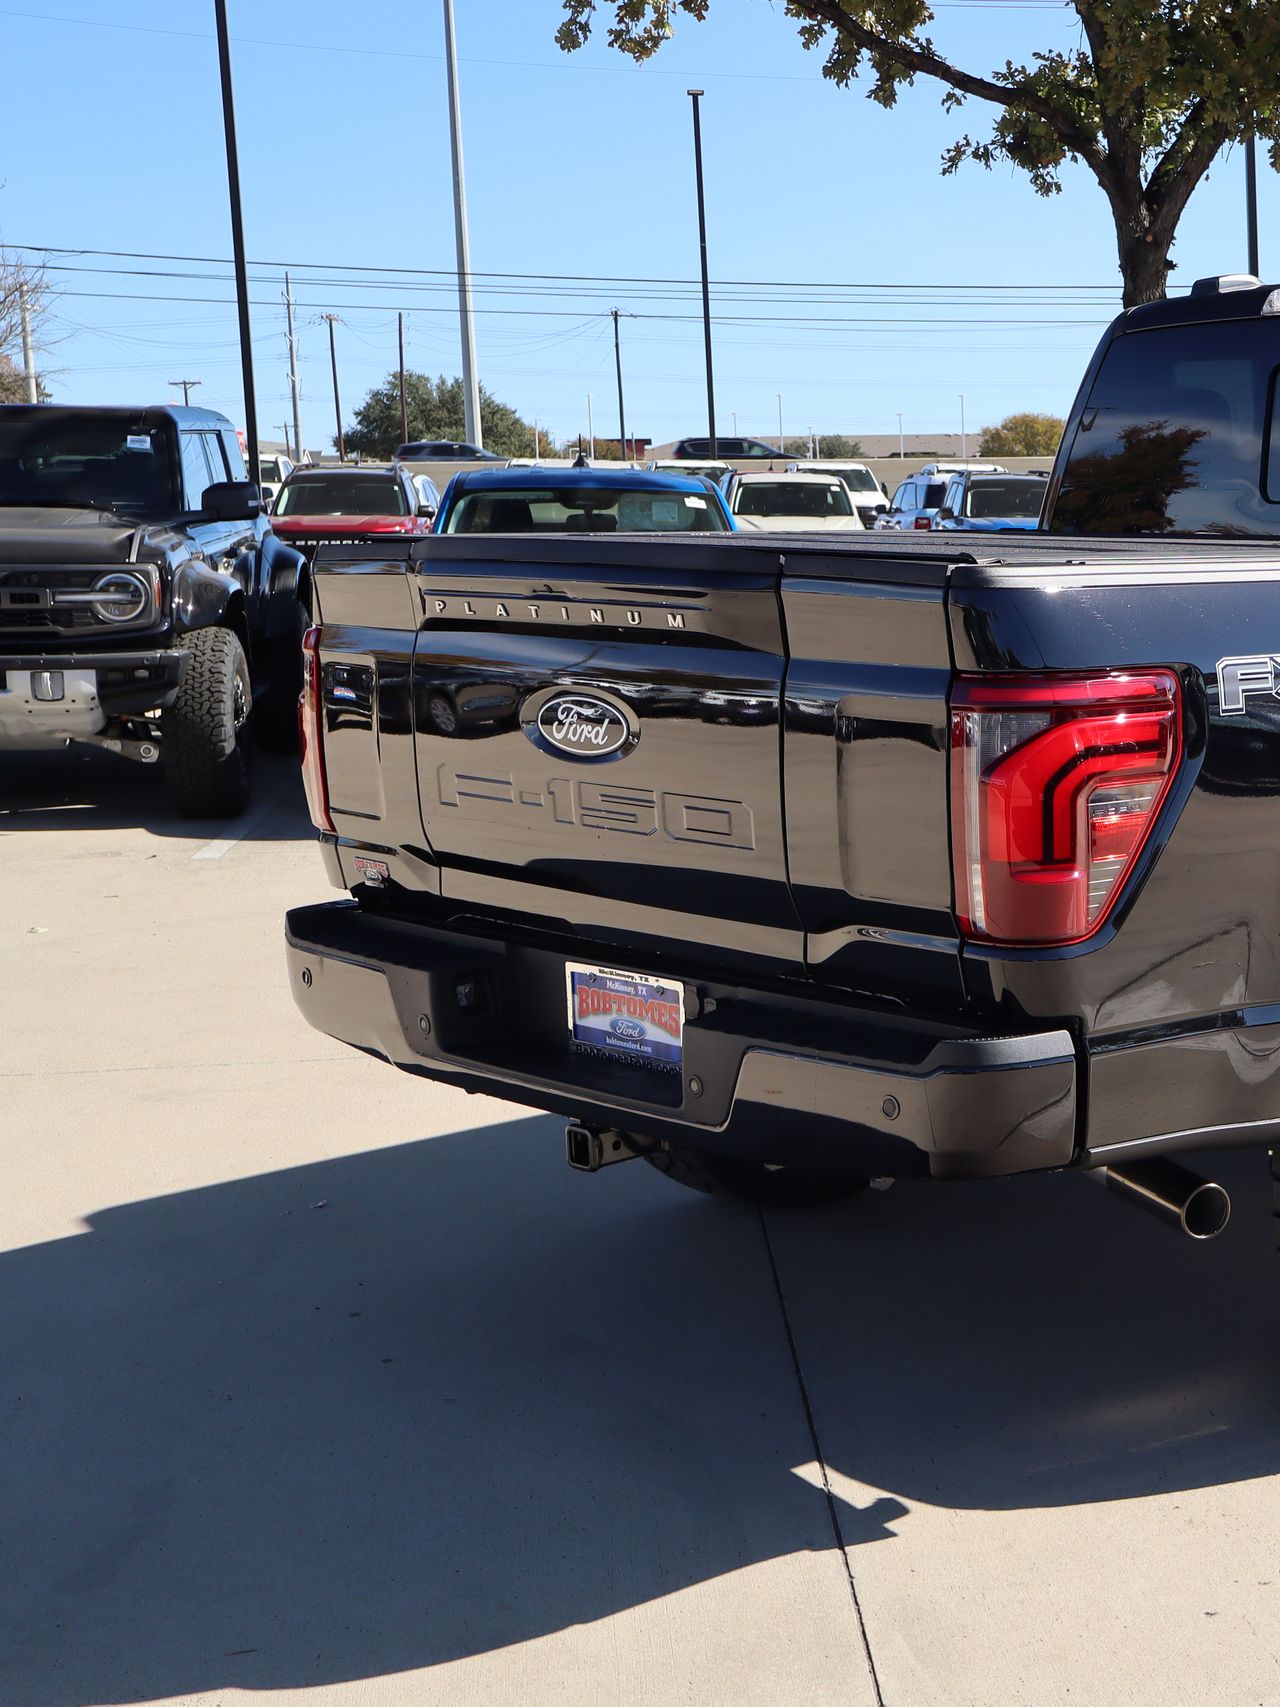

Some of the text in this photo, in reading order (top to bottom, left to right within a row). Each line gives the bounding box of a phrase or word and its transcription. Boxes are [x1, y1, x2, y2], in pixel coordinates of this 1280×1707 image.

[434, 600, 686, 629] PLATINUM
[551, 703, 610, 746] Ford
[437, 762, 756, 851] F-150
[638, 984, 647, 996] TX
[615, 1021, 640, 1038] Ford
